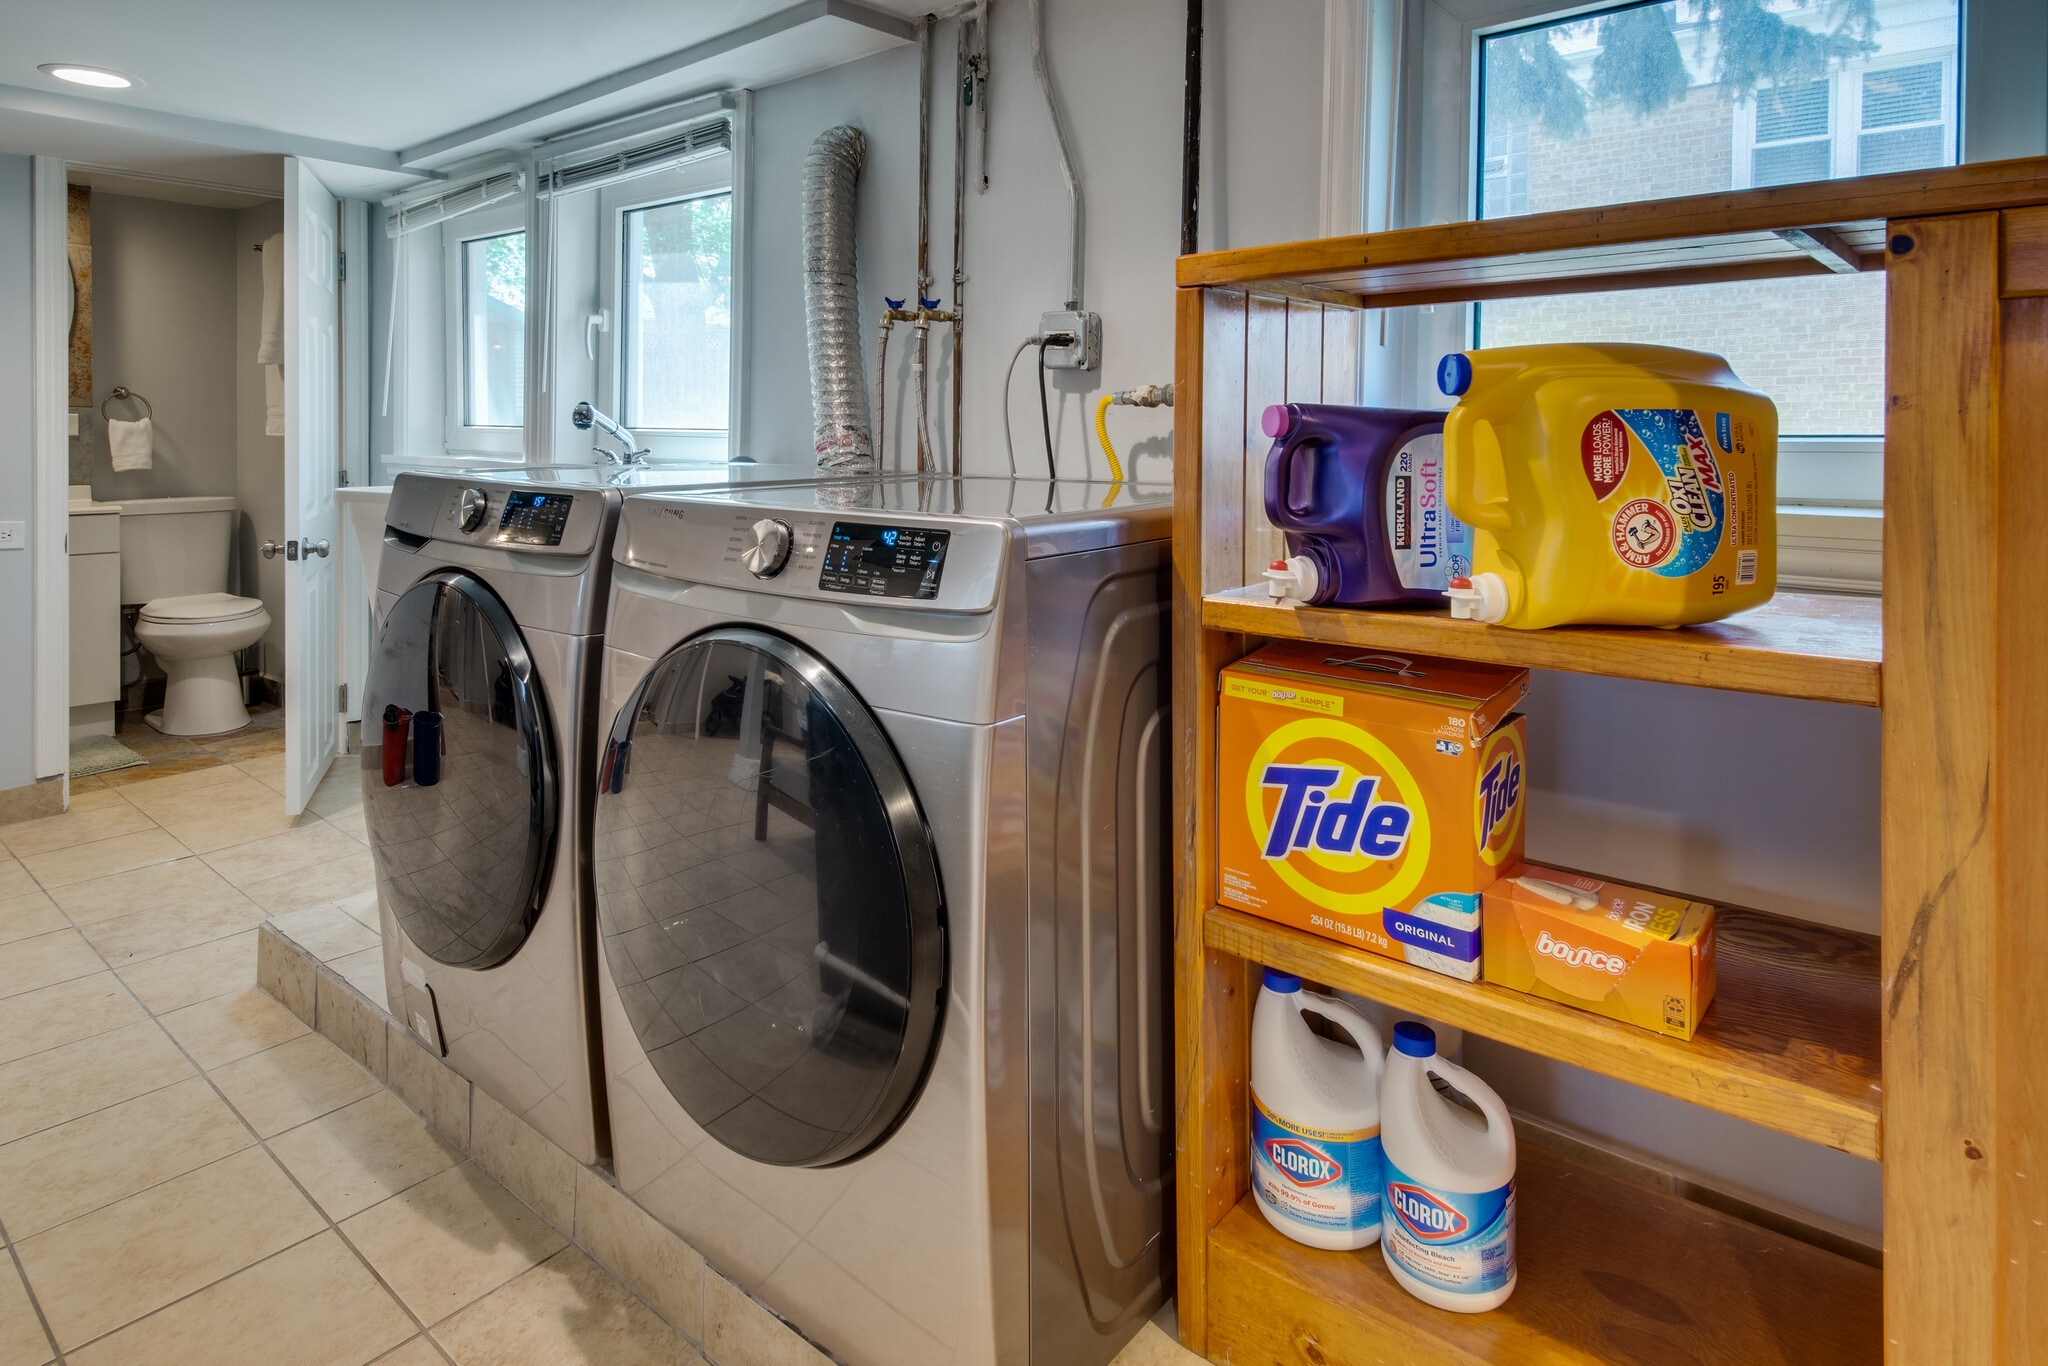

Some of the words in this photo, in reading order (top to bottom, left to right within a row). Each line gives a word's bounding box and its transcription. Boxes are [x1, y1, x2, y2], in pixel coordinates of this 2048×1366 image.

[1593, 422, 1602, 453] LOADS.
[1400, 452, 1408, 472] 220
[1593, 455, 1603, 482] MORE
[1603, 457, 1612, 483] MORE
[1687, 437, 1719, 490] MAX
[1668, 479, 1692, 515] OXI
[1677, 467, 1712, 528] CLEAN
[1728, 472, 1737, 524] CONCENTRATED
[1396, 478, 1405, 546] KIRKLAND
[1616, 503, 1649, 541] HAMMER
[1681, 516, 1690, 533] PLUS
[884, 531, 897, 545] 42
[1619, 544, 1627, 552] &
[1625, 550, 1651, 565] ARM
[1712, 576, 1725, 596] 195
[1231, 684, 1245, 692] GET
[1247, 687, 1268, 696] YOUR
[1448, 716, 1466, 727] 180
[1260, 765, 1412, 859] Tide
[1479, 752, 1521, 855] Tide
[1605, 898, 1624, 921] bounce
[1622, 901, 1657, 933] IRON
[1310, 914, 1323, 926] 254
[1324, 918, 1333, 930] OZ
[1334, 921, 1352, 935] (15.8
[1352, 926, 1365, 940] LB)
[1366, 930, 1377, 943] 7.2
[1378, 934, 1388, 949] kg
[1394, 921, 1455, 948] ORIGINAL
[1644, 908, 1680, 941] LESS
[1536, 931, 1626, 975] bounce
[1279, 1118, 1301, 1132] MORE
[1301, 1127, 1325, 1138] USES!
[1272, 1142, 1331, 1180] CLOROX
[1280, 1188, 1302, 1204] 99.9%
[1394, 1186, 1456, 1233] CLOROX
[1430, 1250, 1455, 1263] Bleach
